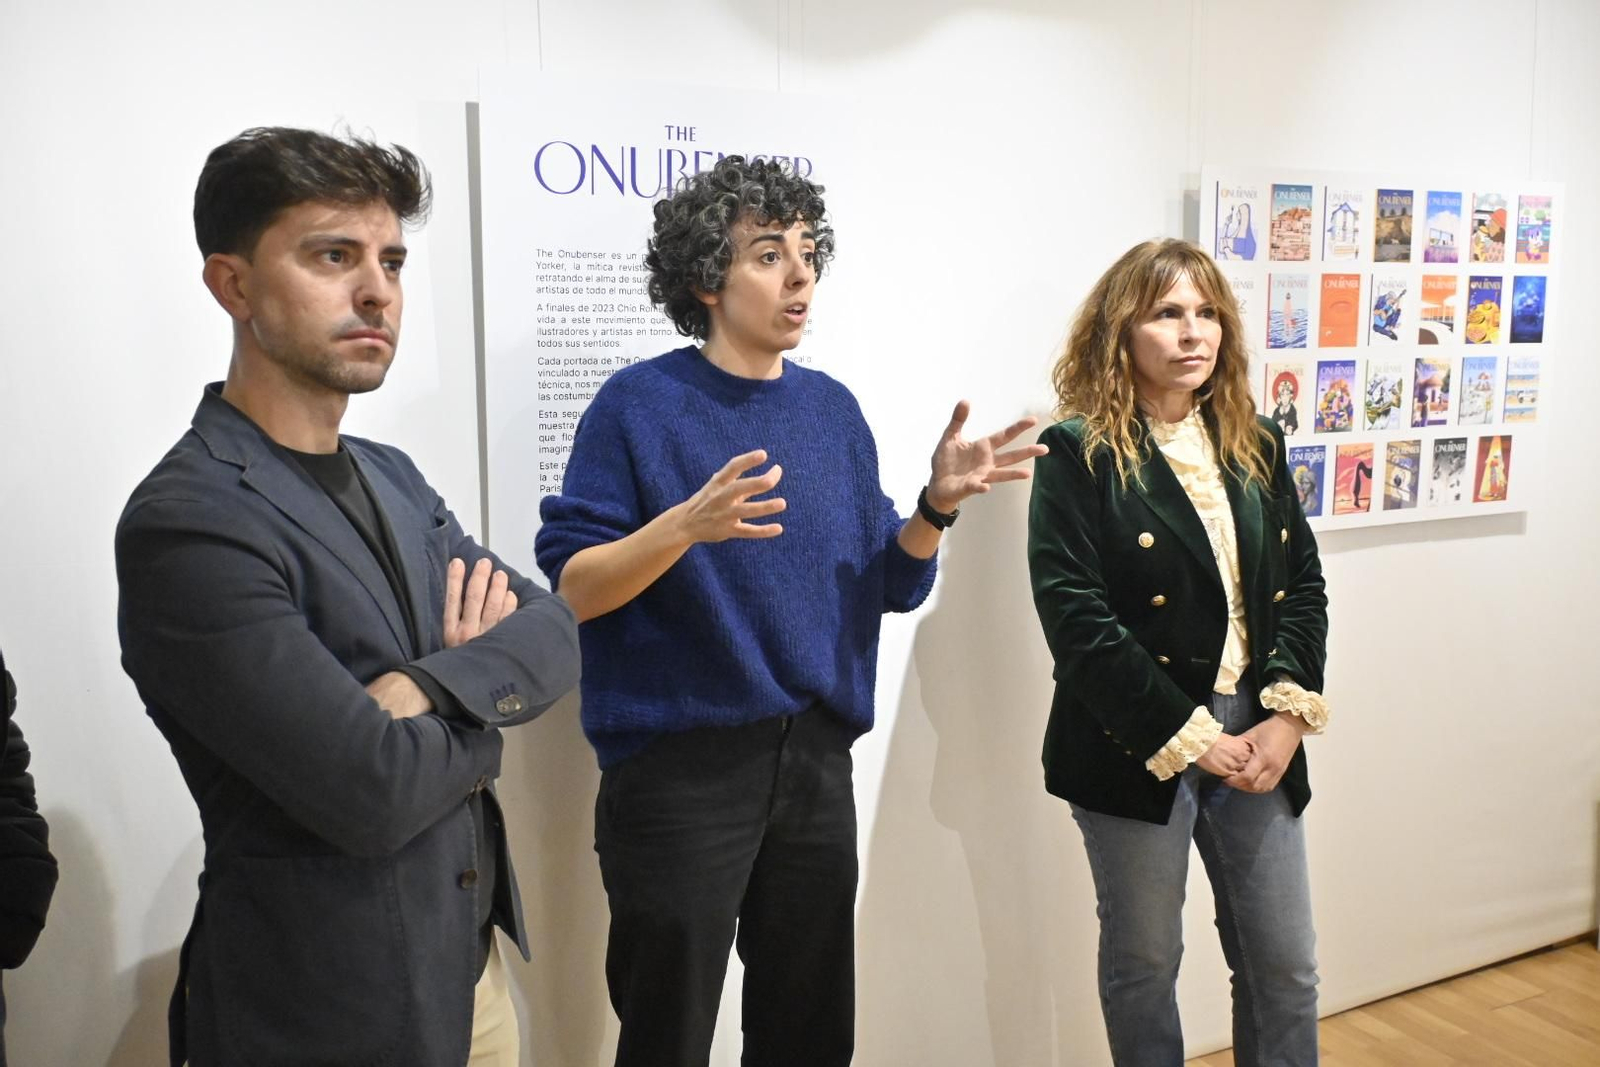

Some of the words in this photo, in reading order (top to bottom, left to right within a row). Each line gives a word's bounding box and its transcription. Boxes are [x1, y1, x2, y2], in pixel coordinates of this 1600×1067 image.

[665, 125, 696, 141] THE
[536, 249, 553, 258] The
[558, 249, 606, 259] Onubenser
[536, 262, 566, 271] Yorker,
[573, 262, 580, 270] la
[536, 274, 583, 282] retratando
[596, 275, 616, 283] alma
[536, 286, 569, 294] artistas
[572, 286, 583, 294] de
[586, 287, 606, 295] todo
[609, 287, 615, 295] el
[546, 304, 575, 312] finales
[578, 304, 589, 312] de
[592, 304, 614, 312] 2023
[537, 316, 555, 324] vida
[601, 328, 633, 336] artistas
[650, 328, 672, 336] torno
[583, 340, 622, 348] sentidos.
[538, 357, 560, 365] Cada
[564, 358, 598, 366] portada
[538, 381, 572, 390] técnica,
[539, 422, 574, 430] muestra
[540, 462, 558, 470] Este
